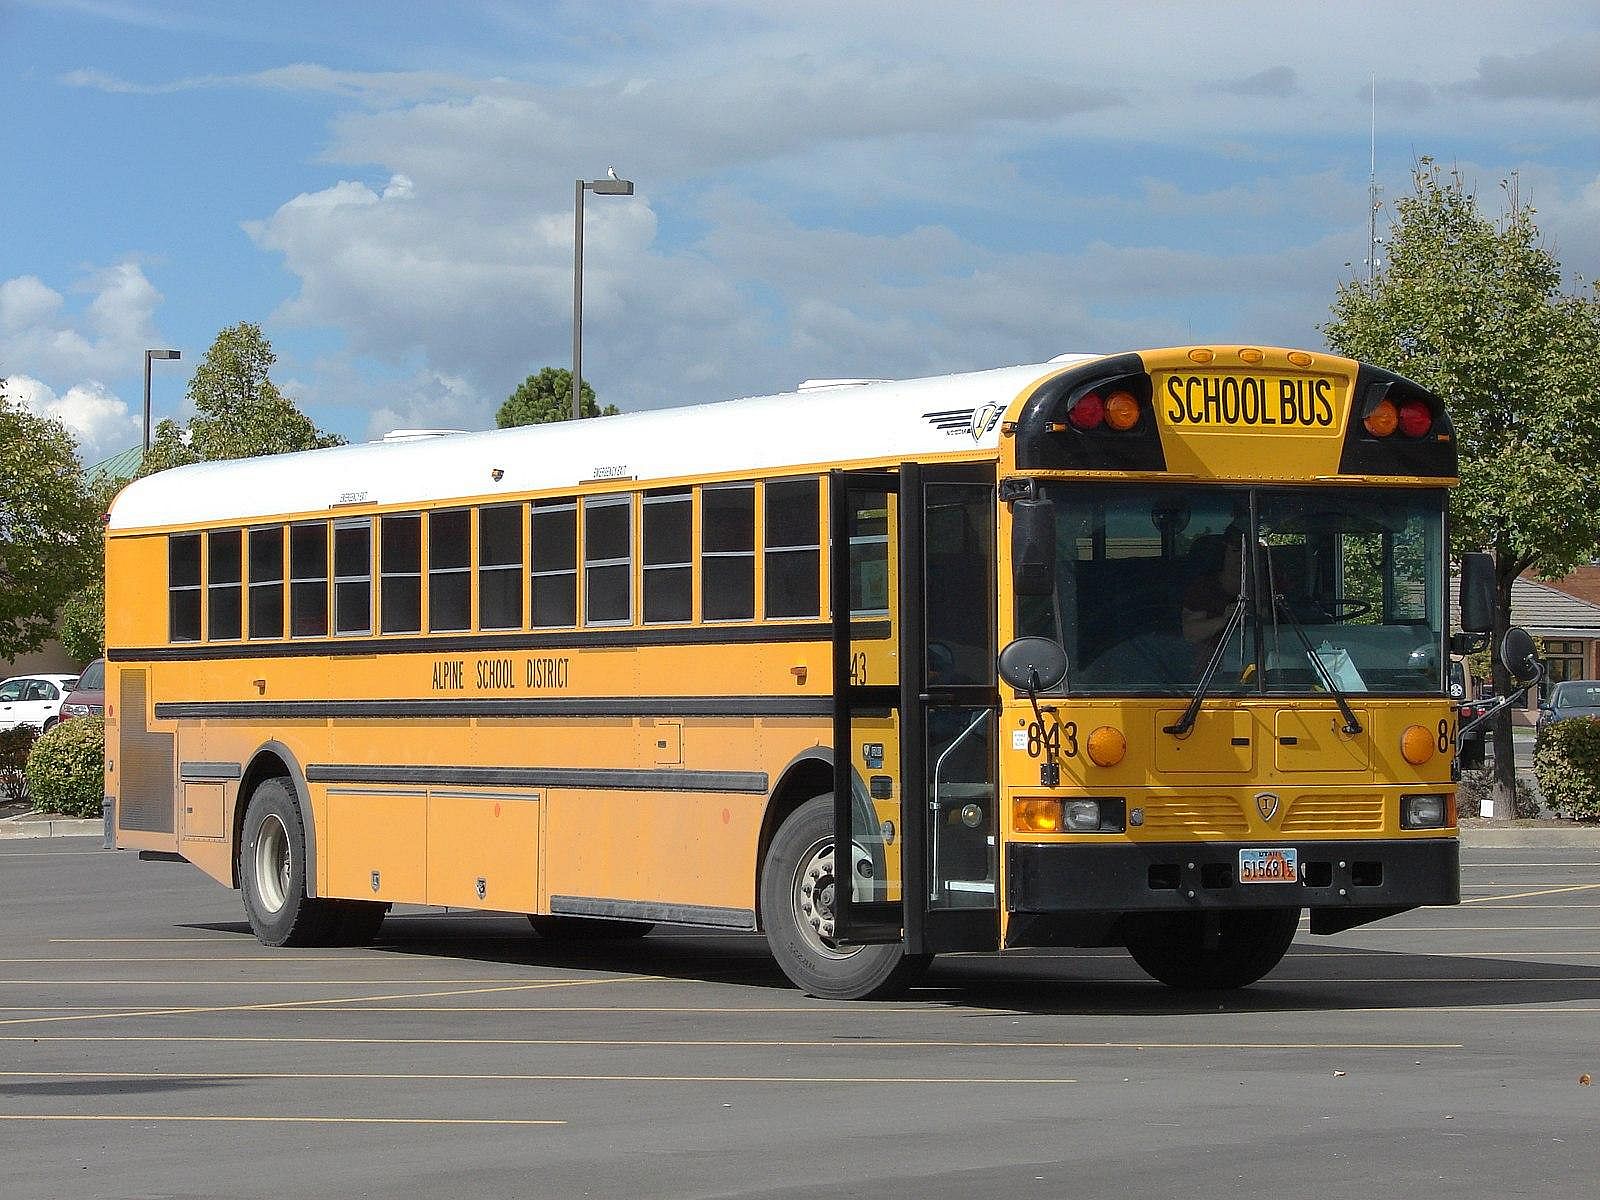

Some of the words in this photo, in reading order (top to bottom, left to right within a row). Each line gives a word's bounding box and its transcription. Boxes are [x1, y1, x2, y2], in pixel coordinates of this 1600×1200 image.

[1168, 376, 1276, 424] SCHOOL
[1280, 379, 1333, 426] BUS
[432, 661, 464, 690] ALPINE
[476, 659, 515, 689] SCHOOL
[526, 658, 569, 688] DISTRICT
[850, 652, 867, 686] 43
[1028, 722, 1078, 758] 843
[1438, 719, 1456, 759] 84
